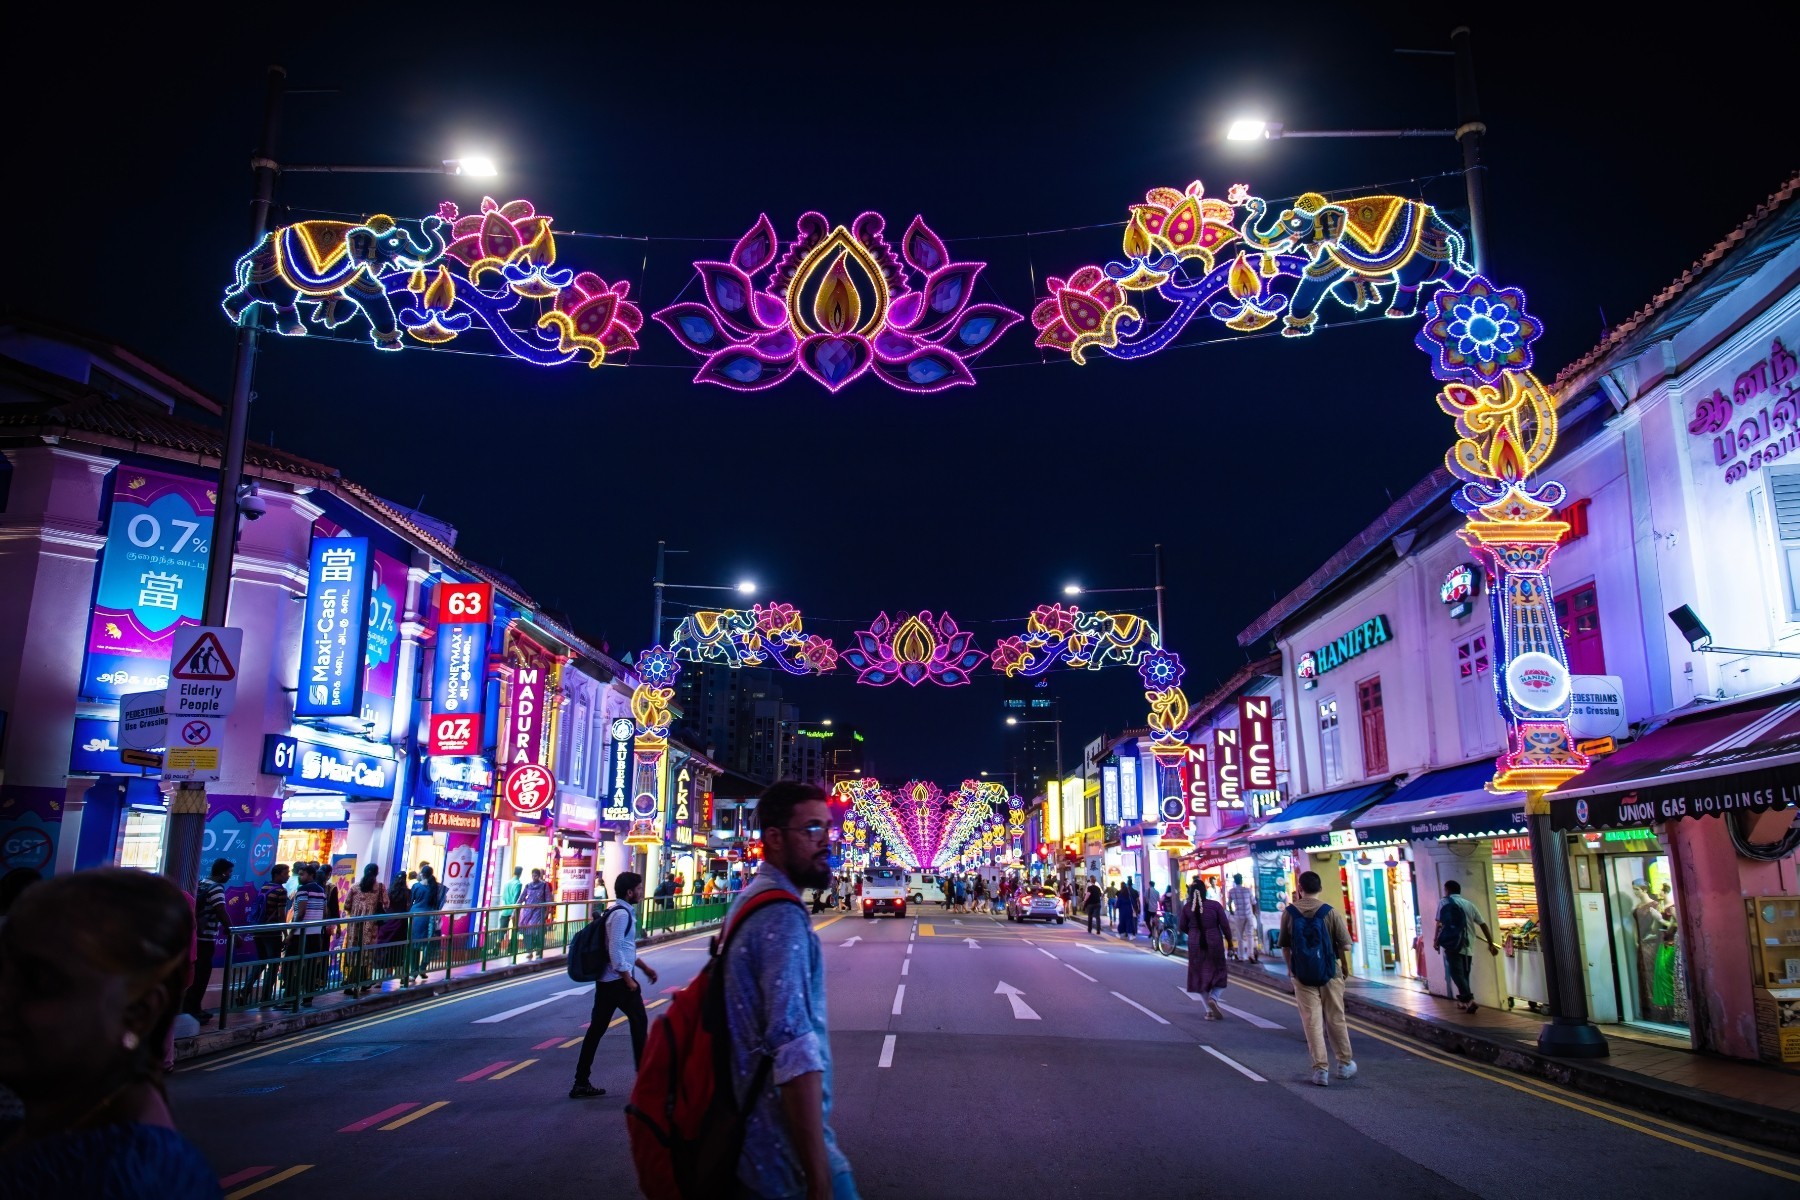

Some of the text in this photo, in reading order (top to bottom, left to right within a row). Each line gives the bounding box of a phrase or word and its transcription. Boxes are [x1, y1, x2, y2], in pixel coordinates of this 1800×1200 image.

[1688, 336, 1799, 435] ஆனந்
[127, 513, 208, 554] 0.7%
[321, 548, 356, 583] 當
[138, 570, 184, 611] 當
[448, 592, 482, 615] 63
[311, 588, 337, 682] Maxi-Cash
[1316, 615, 1387, 674] HANIFFA
[447, 633, 463, 699] MONEYMAX
[1521, 674, 1554, 684] HANIFFA
[179, 698, 219, 712] People
[180, 683, 222, 699] Elderly
[1572, 693, 1618, 703] EDESTRIANS
[125, 705, 166, 719] PEDESTRIAN
[125, 717, 169, 731] Use Crossing
[513, 669, 538, 764] MADURA
[1586, 706, 1620, 717] Crossing
[82, 738, 119, 752] அட
[274, 742, 295, 769] 61
[1246, 700, 1272, 785] NICE
[613, 742, 628, 808] KUBERAN
[1188, 747, 1207, 813] NICE
[1218, 729, 1239, 799] NICE
[513, 768, 546, 808] 當
[676, 768, 690, 820] ALKA
[1618, 786, 1800, 822] UNION GAS HOLDINGS LI
[1428, 822, 1449, 833] Textiles
[254, 843, 273, 858] GST
